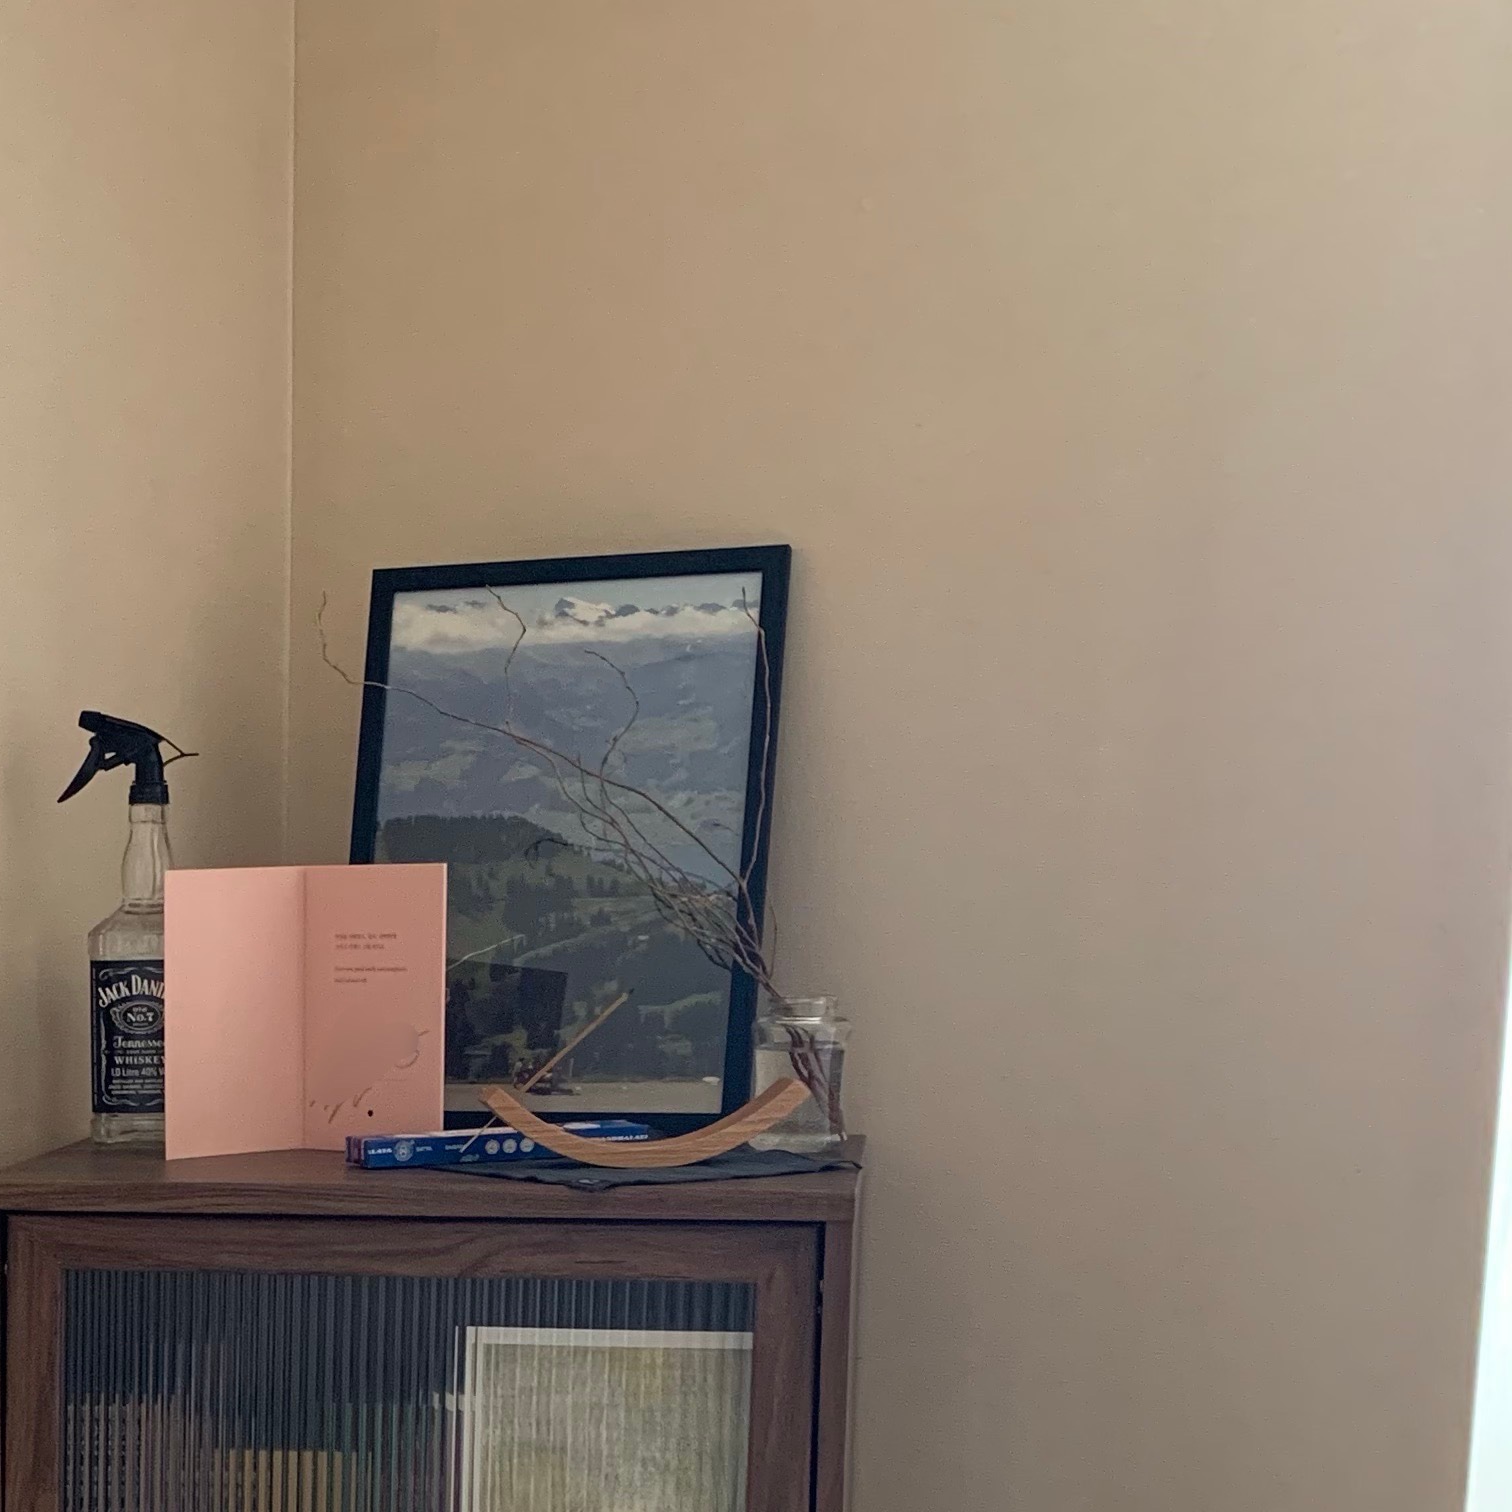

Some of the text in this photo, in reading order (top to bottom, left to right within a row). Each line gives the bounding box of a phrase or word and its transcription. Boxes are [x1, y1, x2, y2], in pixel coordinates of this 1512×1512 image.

[98, 974, 164, 1008] JACK DANI
[113, 1036, 164, 1048] Tennesse
